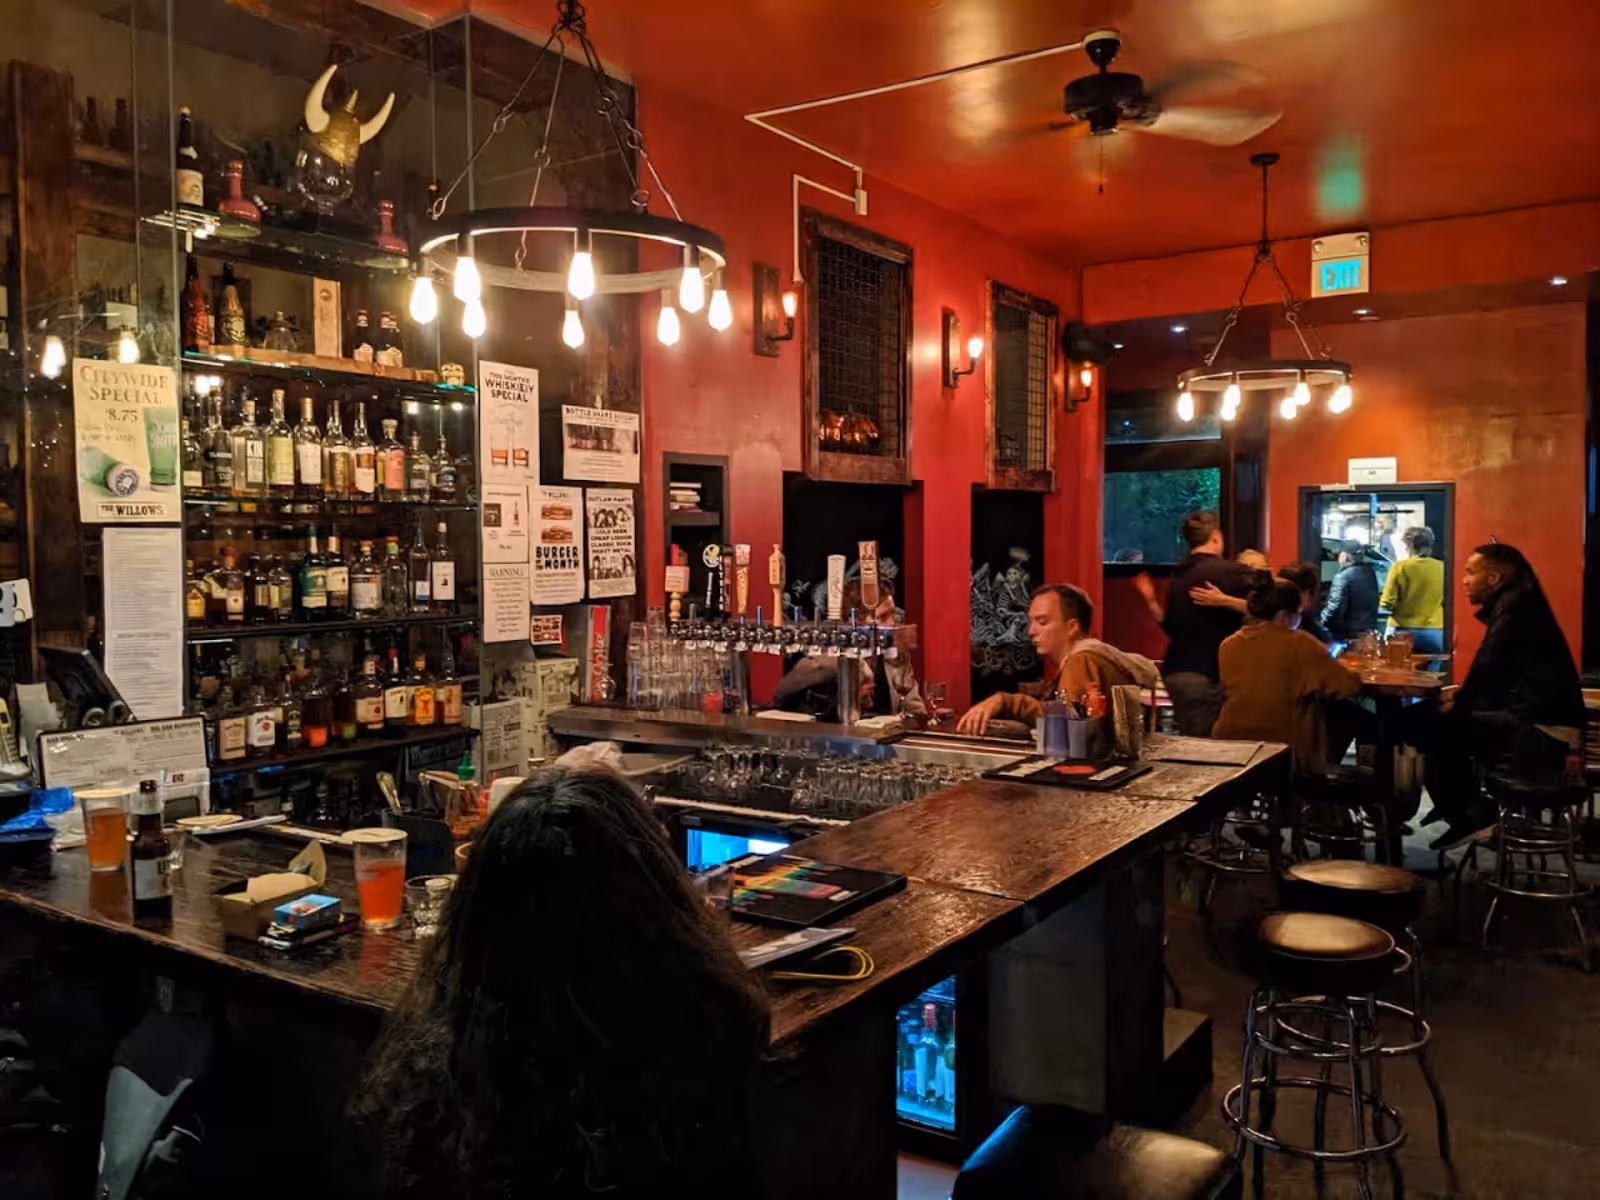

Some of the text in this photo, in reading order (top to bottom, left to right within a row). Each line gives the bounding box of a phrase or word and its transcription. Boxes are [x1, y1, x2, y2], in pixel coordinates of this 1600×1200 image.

[1321, 259, 1361, 291] EXIT
[80, 365, 168, 388] CITYWIDE
[89, 386, 162, 404] SPECIAL
[491, 388, 528, 402] SPECIAL
[115, 504, 164, 516] WILLOWS
[535, 546, 578, 558] BURGER
[545, 559, 579, 570] MONTH
